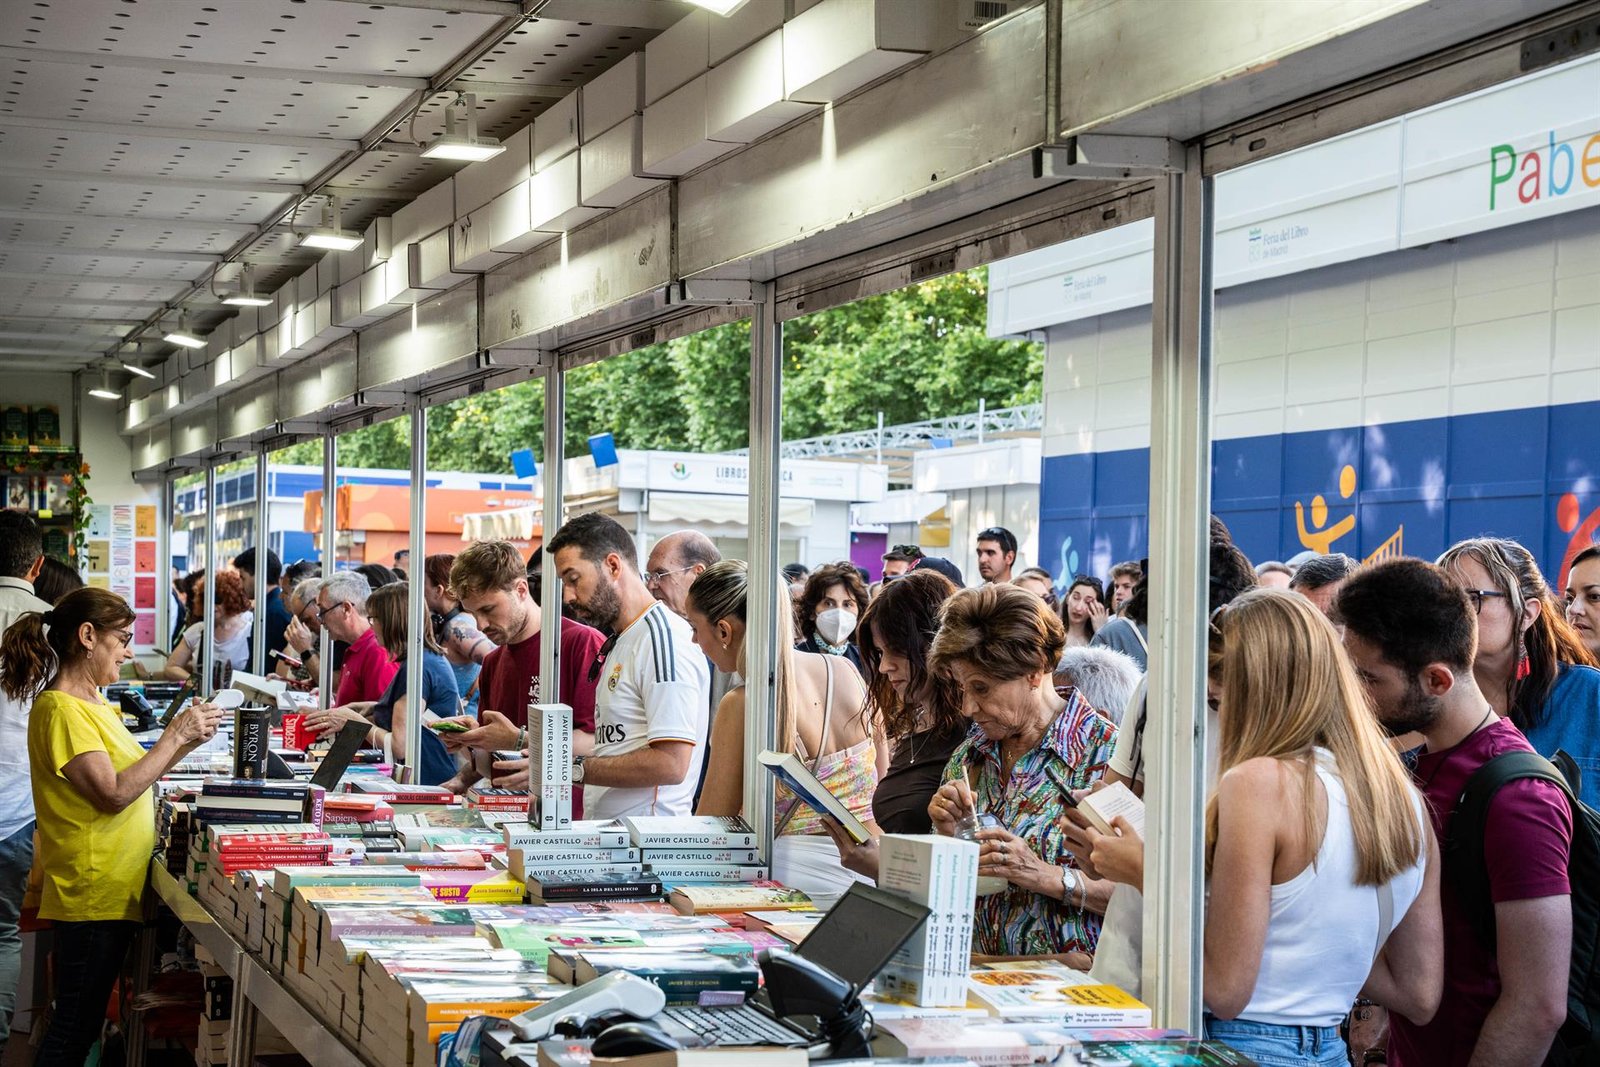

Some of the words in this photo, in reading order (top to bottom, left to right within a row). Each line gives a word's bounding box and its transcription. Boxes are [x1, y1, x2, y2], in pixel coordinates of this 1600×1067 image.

[1263, 232, 1279, 246] Feria
[1291, 225, 1309, 240] Libro
[716, 466, 747, 479] LIBROS
[247, 723, 259, 762] BYRON
[315, 798, 323, 818] KETO
[324, 811, 358, 823] Sapiens
[439, 887, 461, 897] SUSTO
